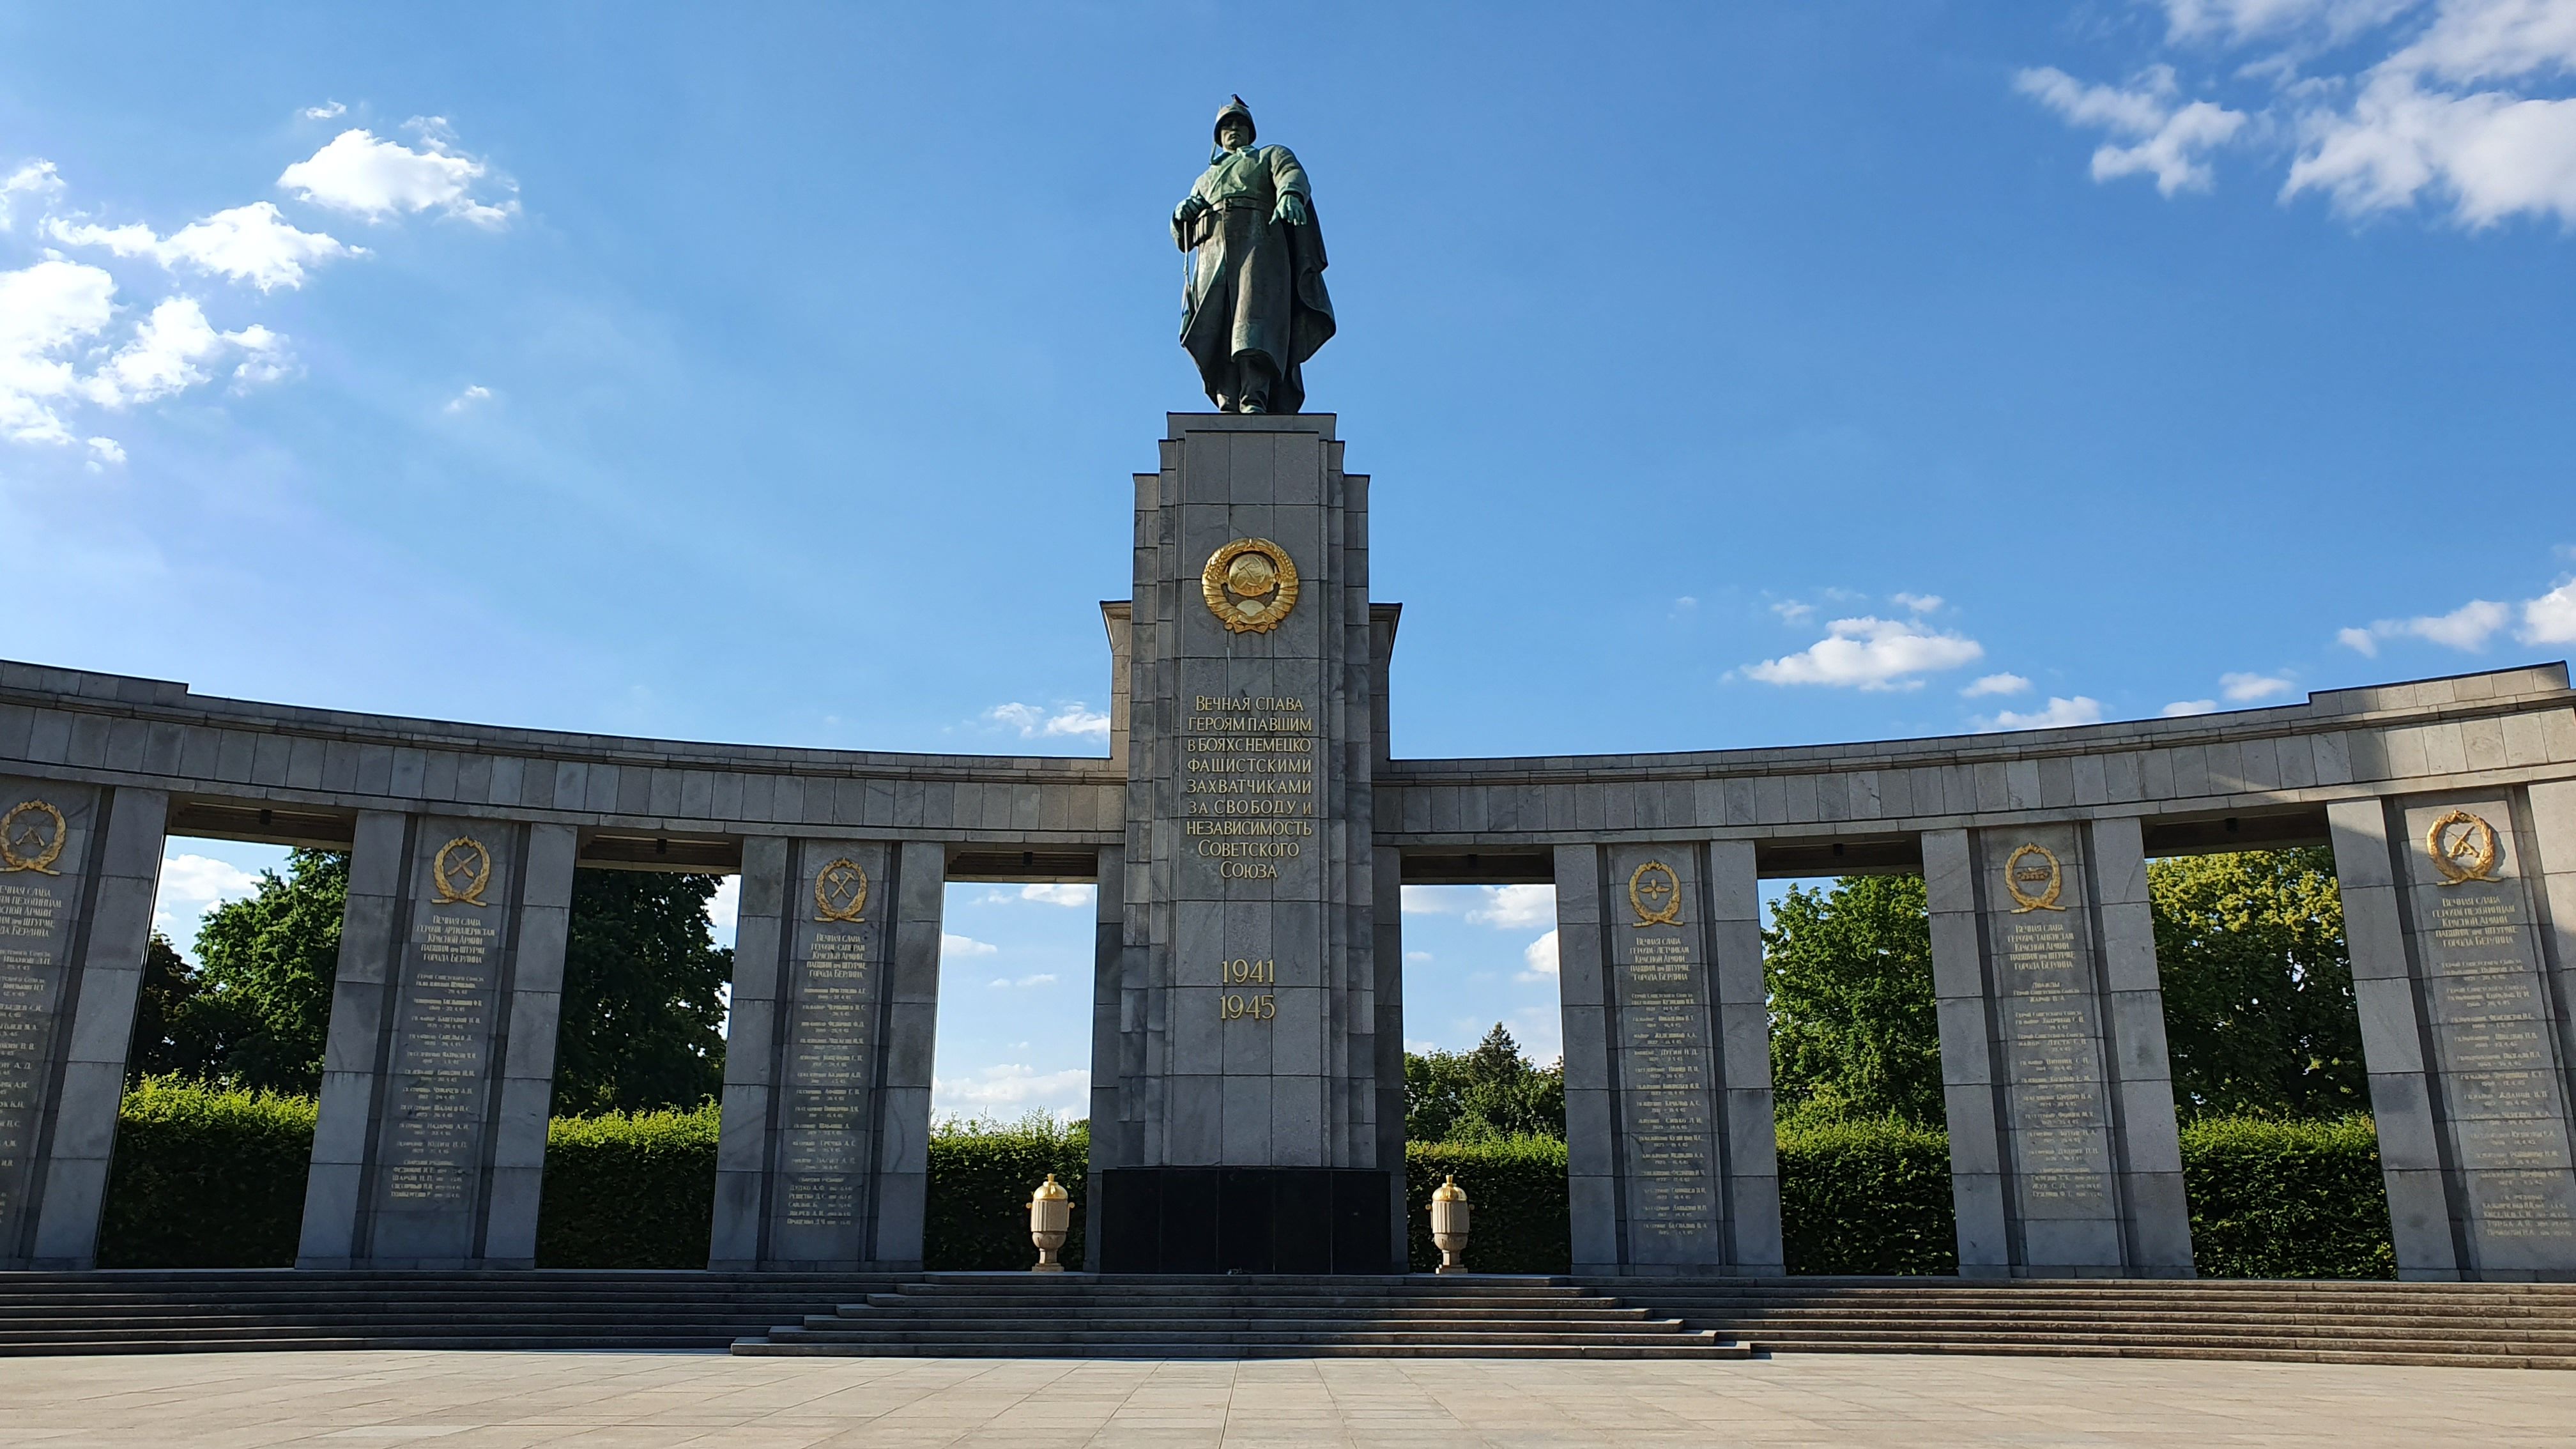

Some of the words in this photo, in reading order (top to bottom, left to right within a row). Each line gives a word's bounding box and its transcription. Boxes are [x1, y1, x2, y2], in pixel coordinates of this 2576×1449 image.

[1196, 696, 1250, 710] ВЕЧНАЯ
[1256, 697, 1303, 710] СЛАВА
[1188, 717, 1245, 731] ГЕРОЯМ
[1248, 718, 1312, 731] ПАВШИМ
[1188, 739, 1195, 751] В
[1199, 739, 1235, 751] БОЯХ
[1236, 739, 1243, 751] С
[1246, 739, 1310, 752] НЕМЕЦКО
[1188, 758, 1311, 772] ФАШИСТСКИМИ
[1187, 779, 1311, 793] ЗАХВАТЧИКАМИ
[1189, 801, 1208, 814] ЗА
[1215, 800, 1296, 814] СВОБОДУ
[1303, 802, 1311, 815] И
[1187, 821, 1312, 836] НЕЗАВИСИМОСТЬ
[1199, 839, 1299, 857] СОВЕТСКОГО
[1221, 861, 1277, 878] СОЮЗА
[1222, 959, 1274, 983] 1941
[1220, 995, 1275, 1019] 1945
